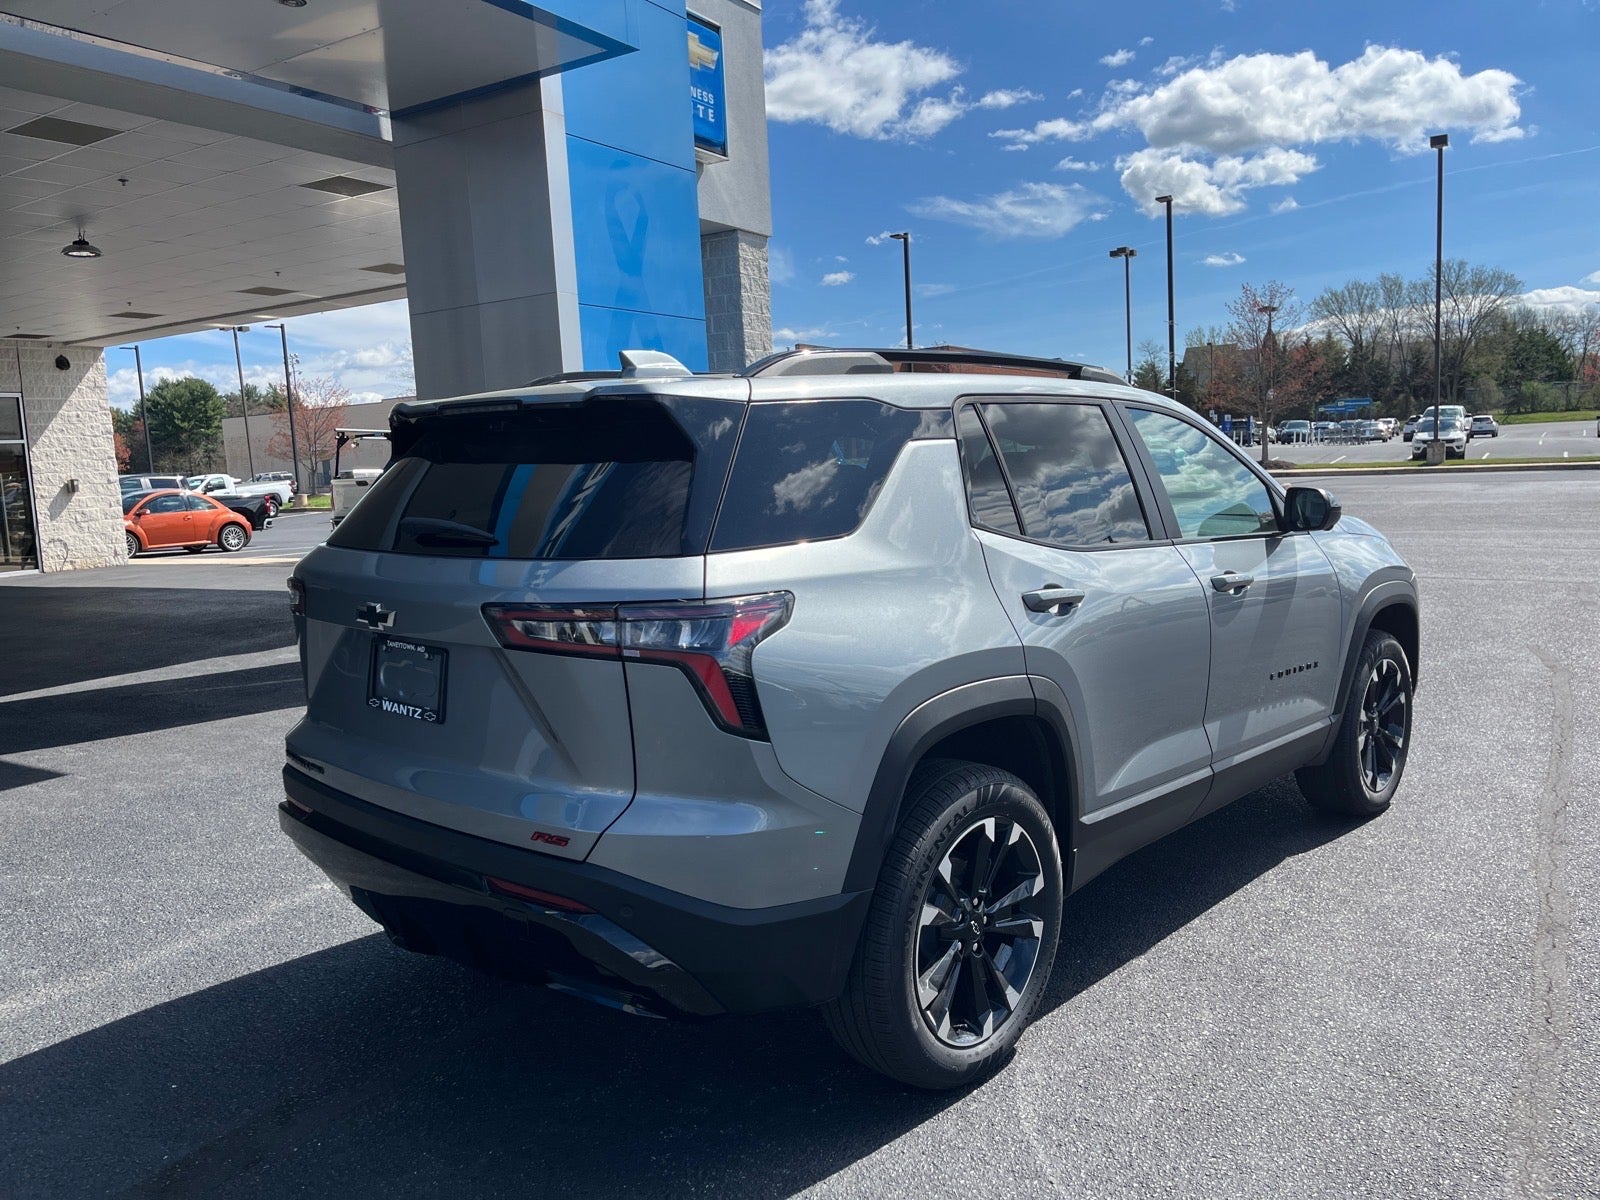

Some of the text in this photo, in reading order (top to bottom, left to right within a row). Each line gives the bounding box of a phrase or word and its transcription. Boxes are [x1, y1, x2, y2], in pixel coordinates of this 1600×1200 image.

[1269, 661, 1319, 681] EQUINOX
[382, 700, 422, 719] WANTZ
[531, 831, 571, 848] RS
[903, 804, 970, 958] ONTINENTAL
